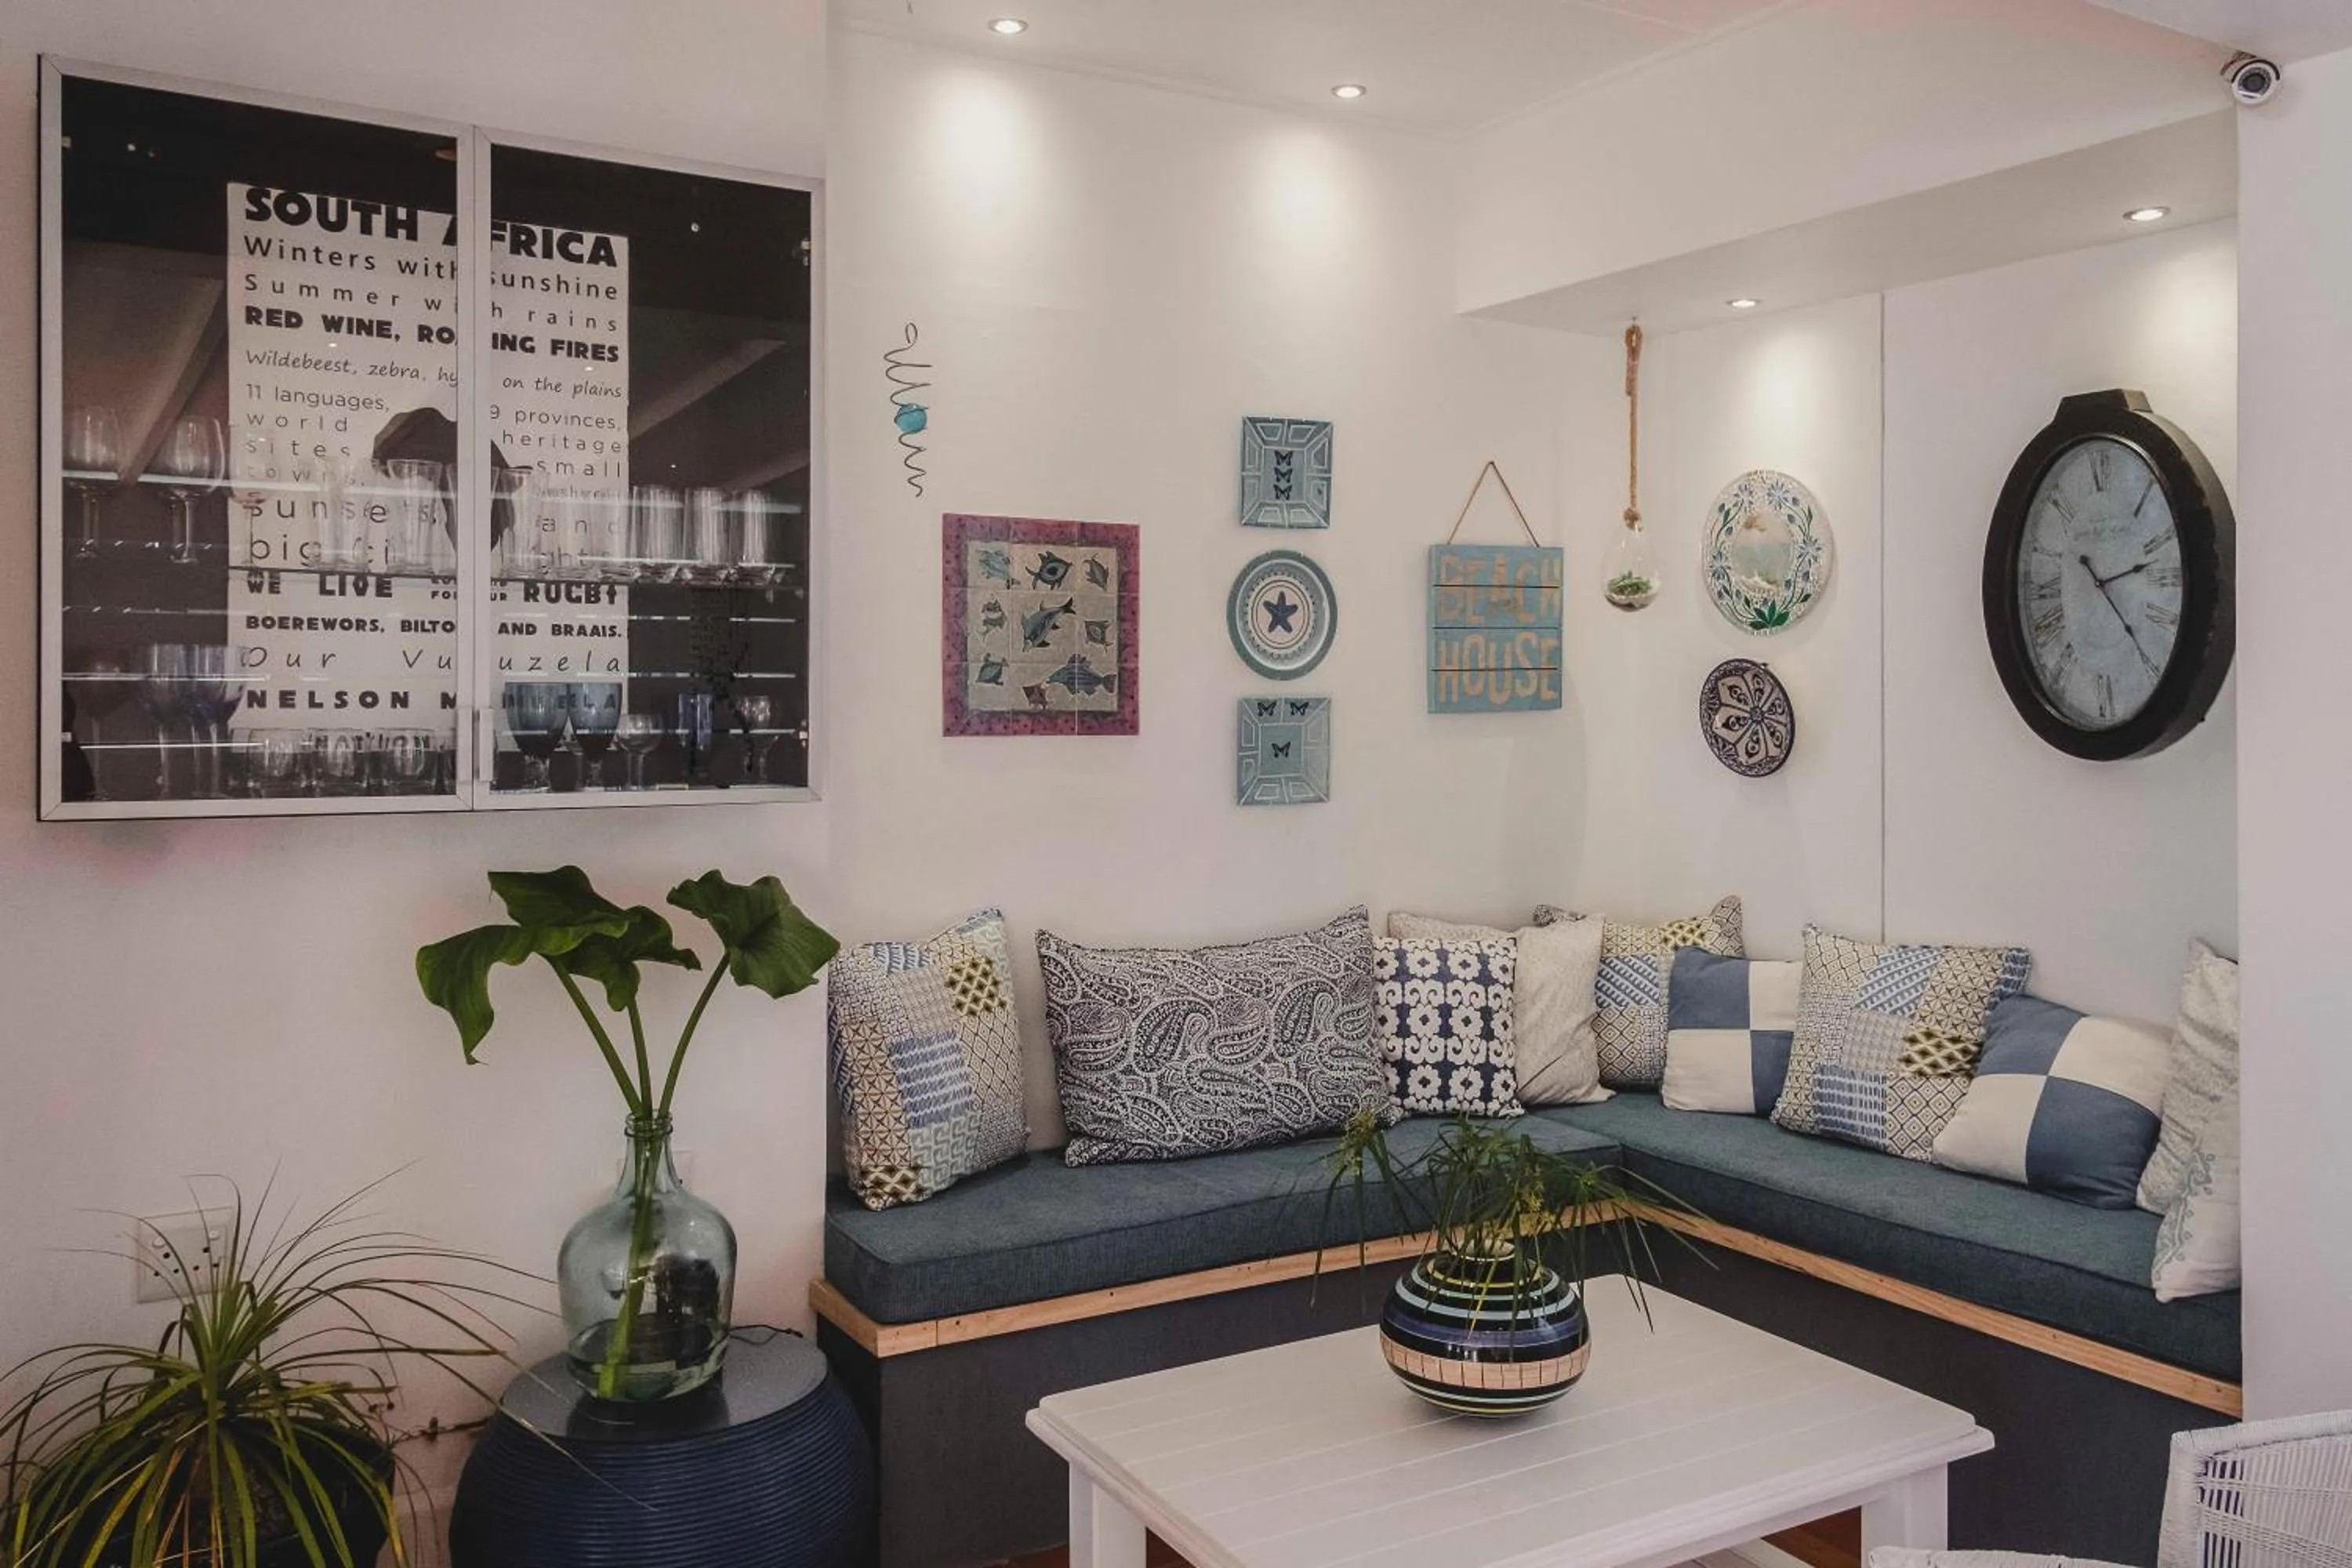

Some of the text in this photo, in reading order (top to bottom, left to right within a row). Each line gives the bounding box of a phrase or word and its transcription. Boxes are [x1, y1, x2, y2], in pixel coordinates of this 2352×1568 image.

[245, 187, 418, 242] SOUTH
[244, 235, 376, 271] Winters
[245, 274, 399, 307] Summer
[528, 310, 616, 332] rains
[245, 305, 619, 362] RED WINE, ROING FIRES
[247, 383, 261, 400] 11
[274, 386, 390, 412] languages,
[503, 377, 524, 389] on
[534, 376, 562, 393] the
[572, 380, 622, 400] plains
[246, 412, 622, 454] world heritage
[246, 439, 620, 477] sites small
[246, 572, 281, 594] WE
[319, 573, 393, 598] LIVE
[1438, 553, 1560, 625] BEACH
[245, 615, 622, 638] BOEREWORS, BILTO AND BRAAIS.
[240, 647, 620, 673] Our Vuuzela
[1438, 631, 1559, 704] HOUSE
[247, 689, 409, 710] NELSON
